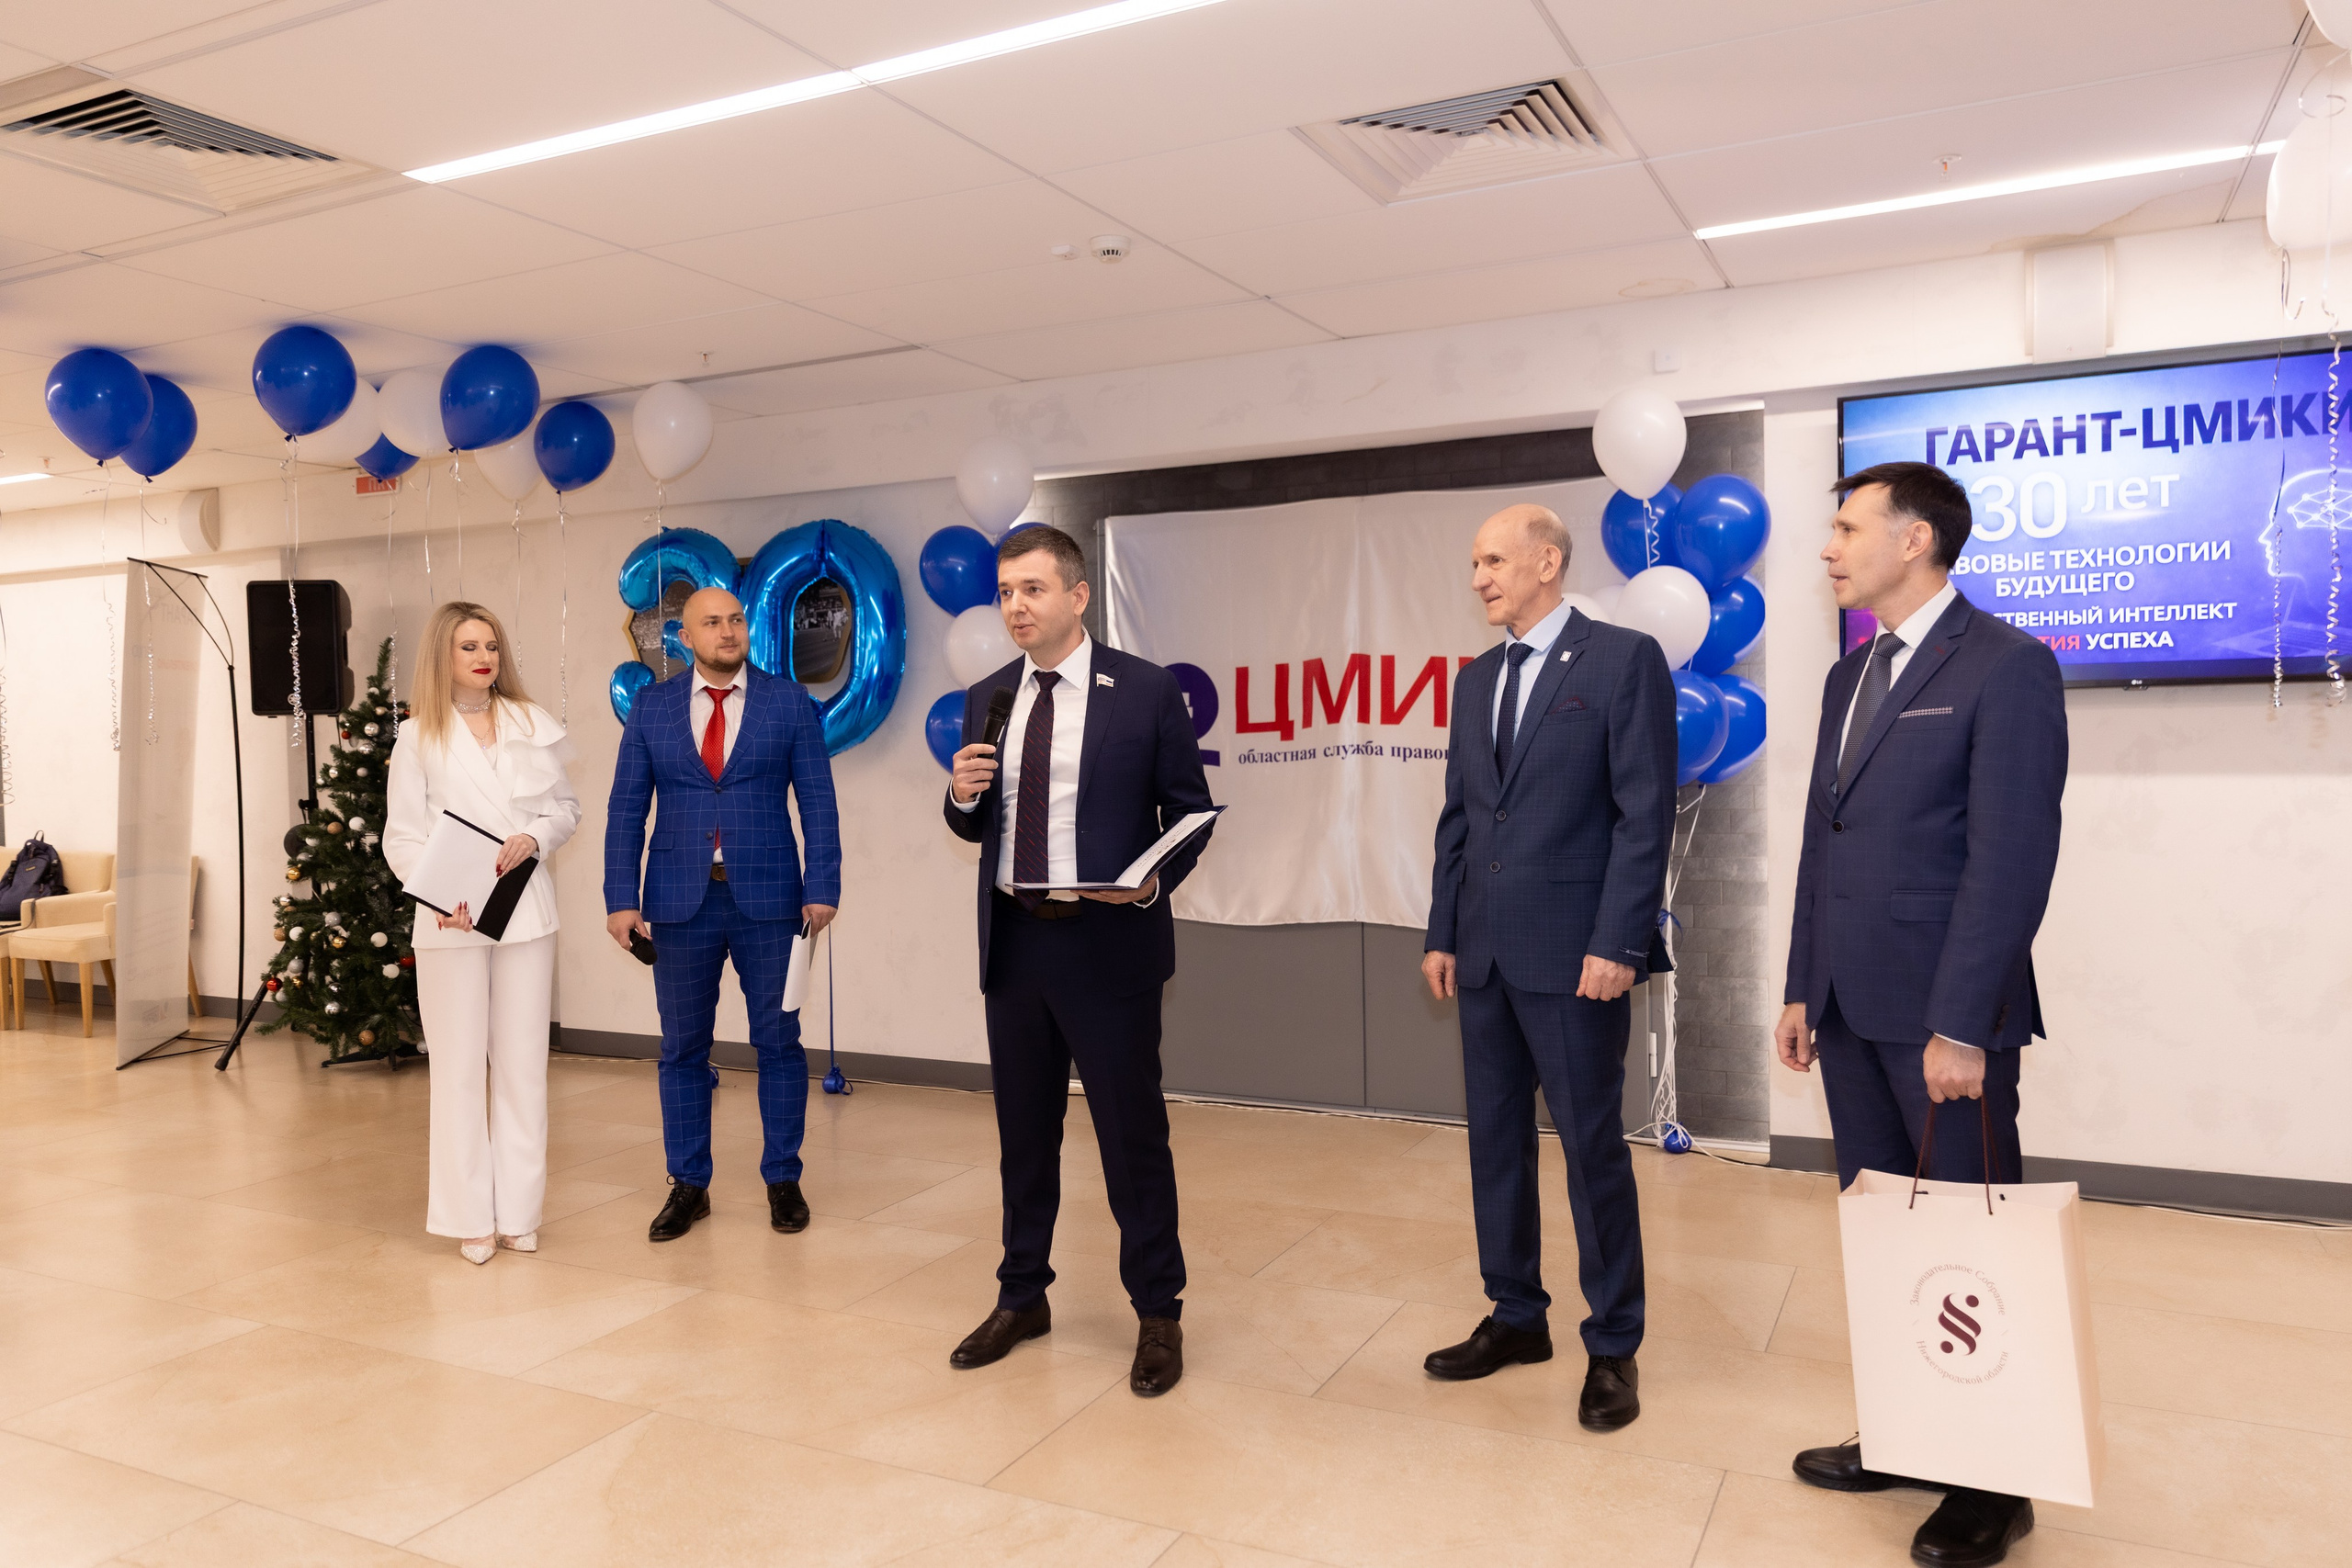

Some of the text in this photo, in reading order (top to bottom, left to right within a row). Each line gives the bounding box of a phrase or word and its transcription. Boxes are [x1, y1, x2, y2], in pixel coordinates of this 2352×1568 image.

[1926, 389, 2352, 467] ГАРАНТ-ЦМИКИ
[1969, 470, 2180, 542] 30 лет
[1950, 540, 2231, 576] ВОВЫЕ ТЕХНОЛОГИИ
[1996, 570, 2135, 599] БУДУЩЕГО
[1993, 602, 2238, 627] ТВЕННЫЙ ИНТЕЛЛЕКТ
[2086, 631, 2175, 650] УСПЕХА
[1235, 653, 1475, 741] ЦМИ
[1238, 740, 1448, 764] областная служба право
[1910, 1263, 2006, 1316] Законодательное Собрание
[1916, 1339, 2009, 1385] Нижегородской области
